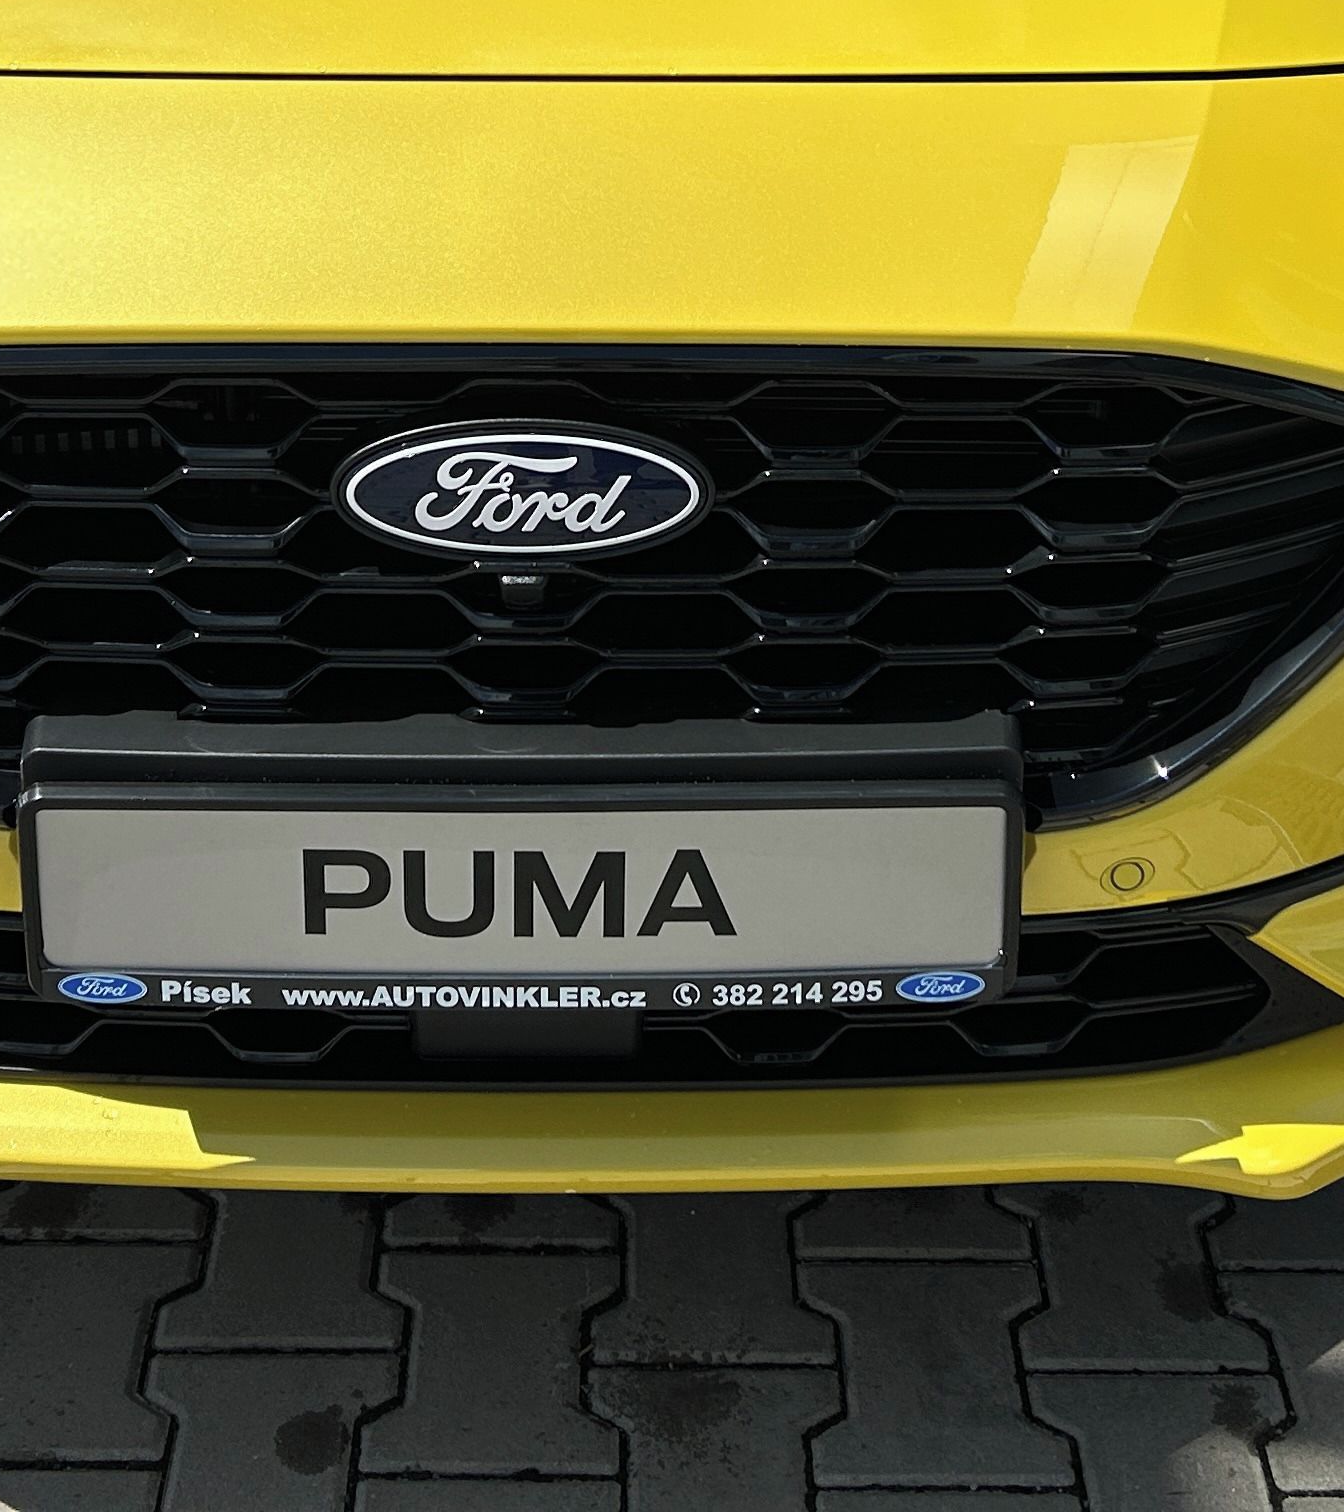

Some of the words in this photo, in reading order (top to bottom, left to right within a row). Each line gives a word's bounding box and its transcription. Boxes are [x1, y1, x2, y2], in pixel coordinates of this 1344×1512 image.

[414, 451, 632, 533] Ford
[303, 849, 737, 939] PUMA
[75, 975, 128, 998] Ford
[161, 979, 253, 1006] Písek
[281, 985, 647, 1008] www.AUTOVINKLER.cz
[713, 984, 763, 1007] 382
[771, 983, 825, 1005] 214
[831, 980, 883, 1003] 295
[914, 976, 966, 997] Ford
